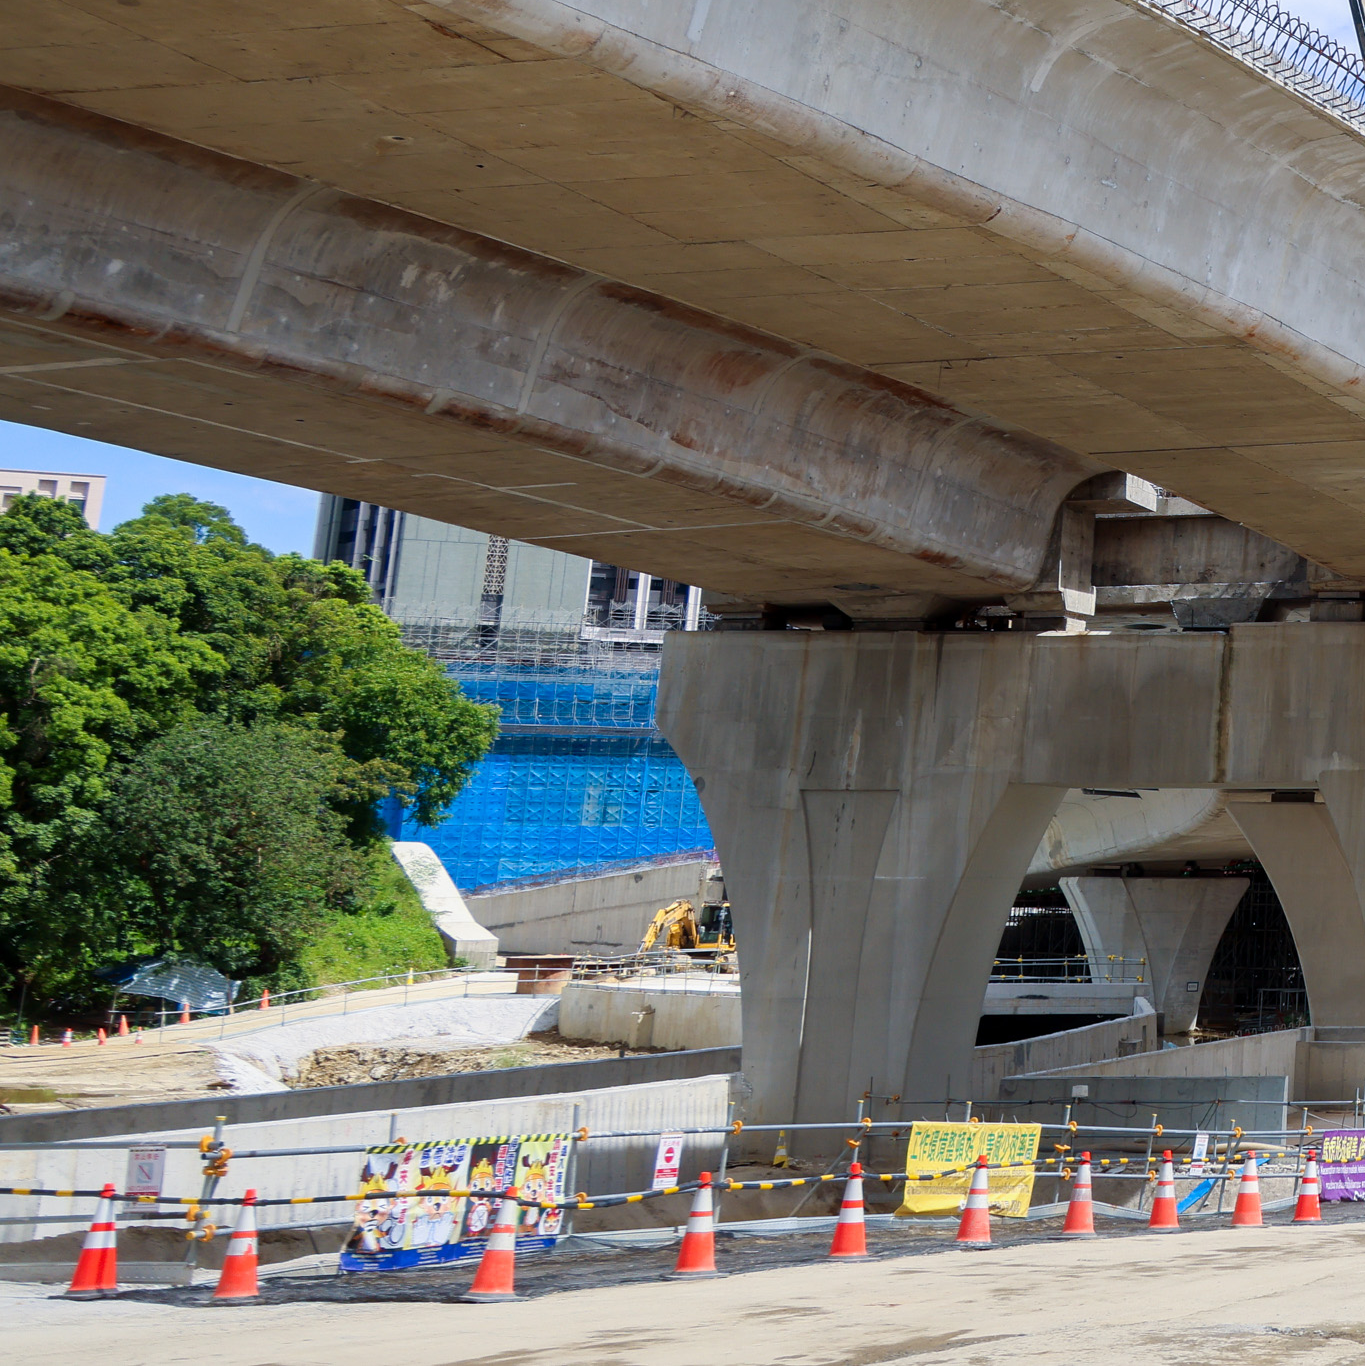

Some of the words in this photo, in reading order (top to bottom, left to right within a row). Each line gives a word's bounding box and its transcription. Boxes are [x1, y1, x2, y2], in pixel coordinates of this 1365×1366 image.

[910, 1130, 977, 1162] 工作環境整頓好
[977, 1131, 1037, 1162] 災害減少效率高
